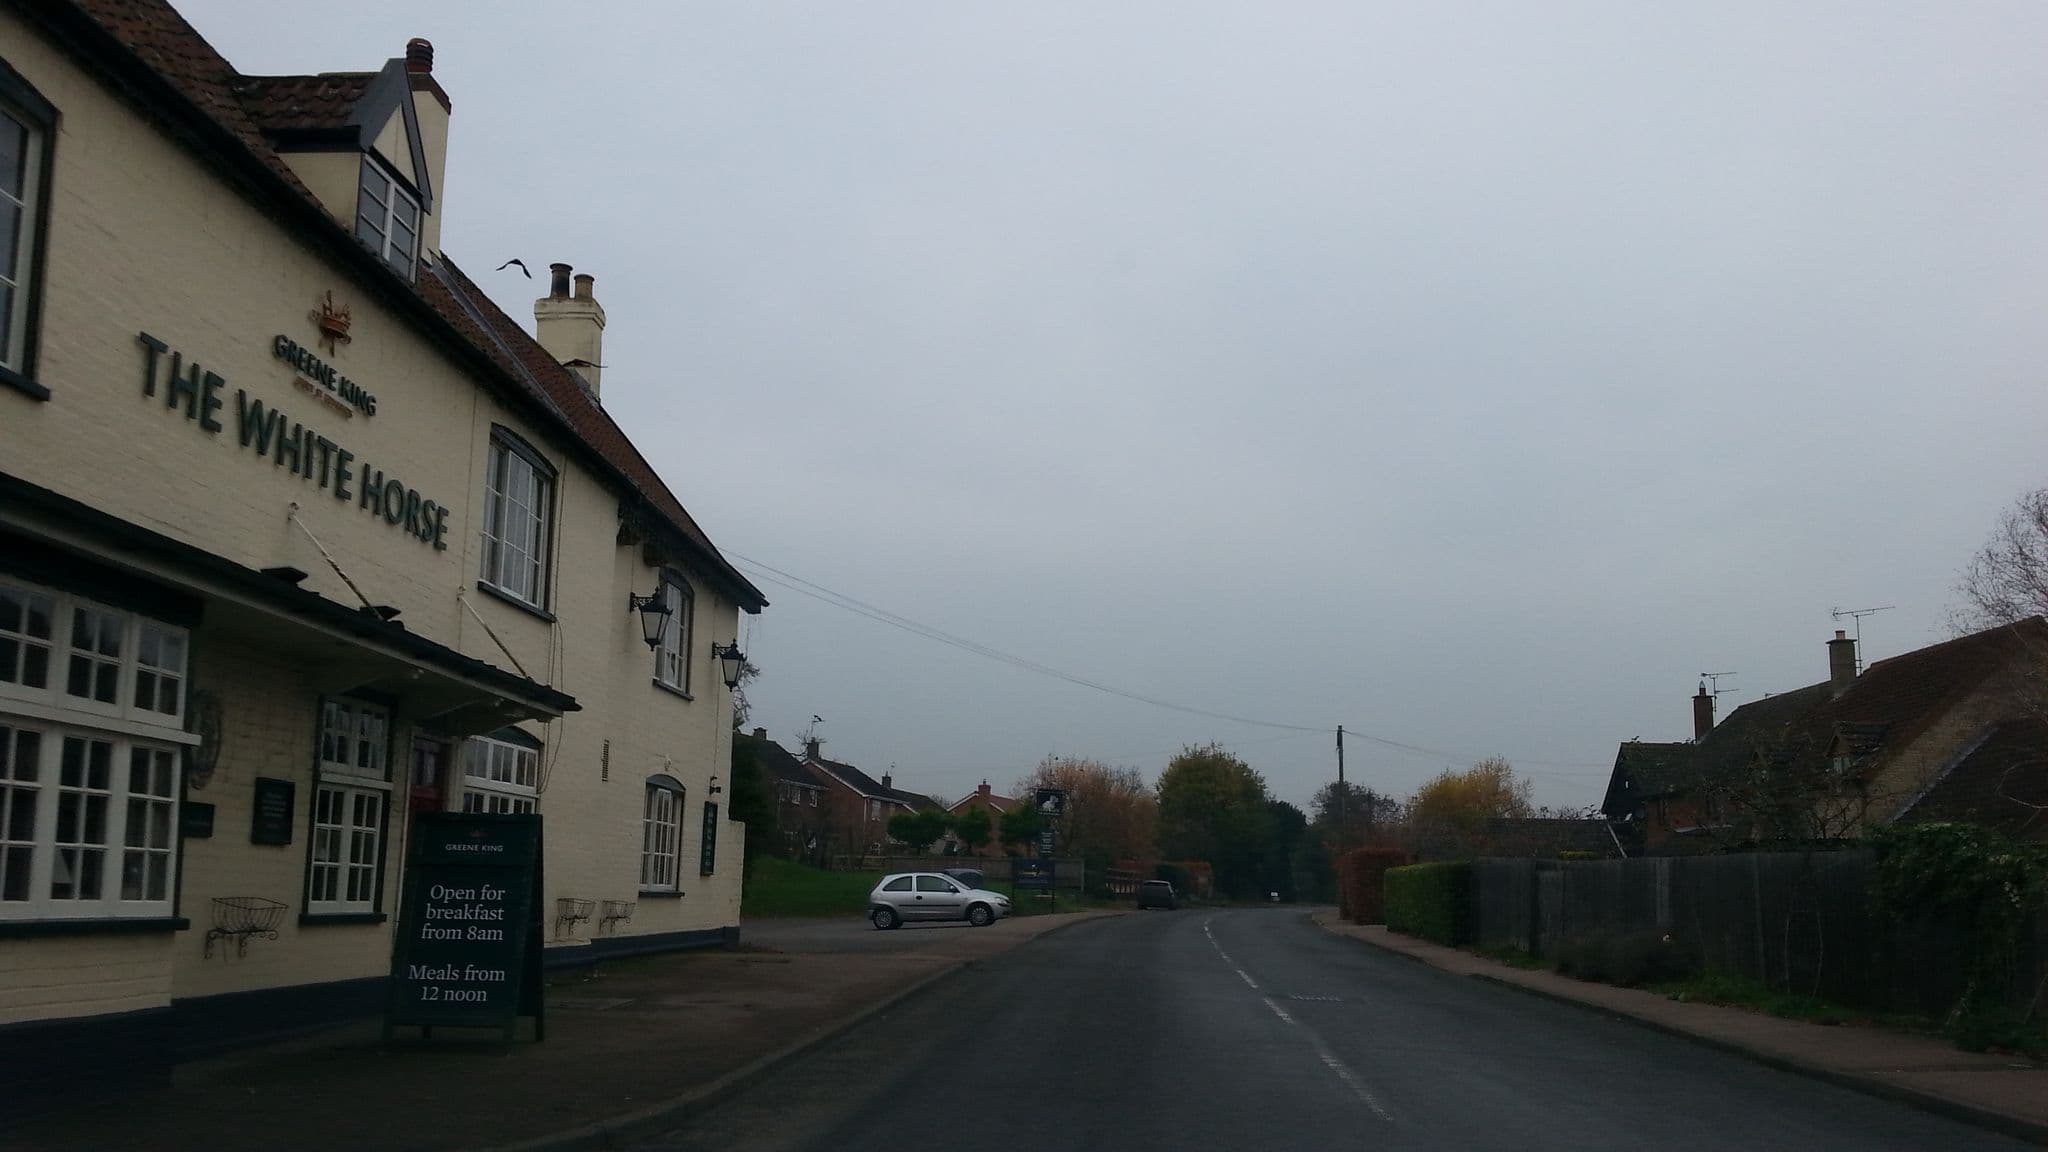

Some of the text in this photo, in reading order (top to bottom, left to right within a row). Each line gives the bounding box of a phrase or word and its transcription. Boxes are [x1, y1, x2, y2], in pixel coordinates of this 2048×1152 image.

[274, 334, 338, 391] GREENE
[337, 375, 378, 418] KING
[136, 330, 227, 433] THE
[237, 388, 354, 501] WHITE
[359, 462, 450, 551] HORSE
[445, 843, 504, 853] GREENE KING
[430, 884, 506, 904] Open for
[425, 903, 505, 921] breakfast
[420, 923, 504, 941] from 8am
[408, 964, 505, 982] Meals from
[420, 986, 488, 1002] 12 noon
